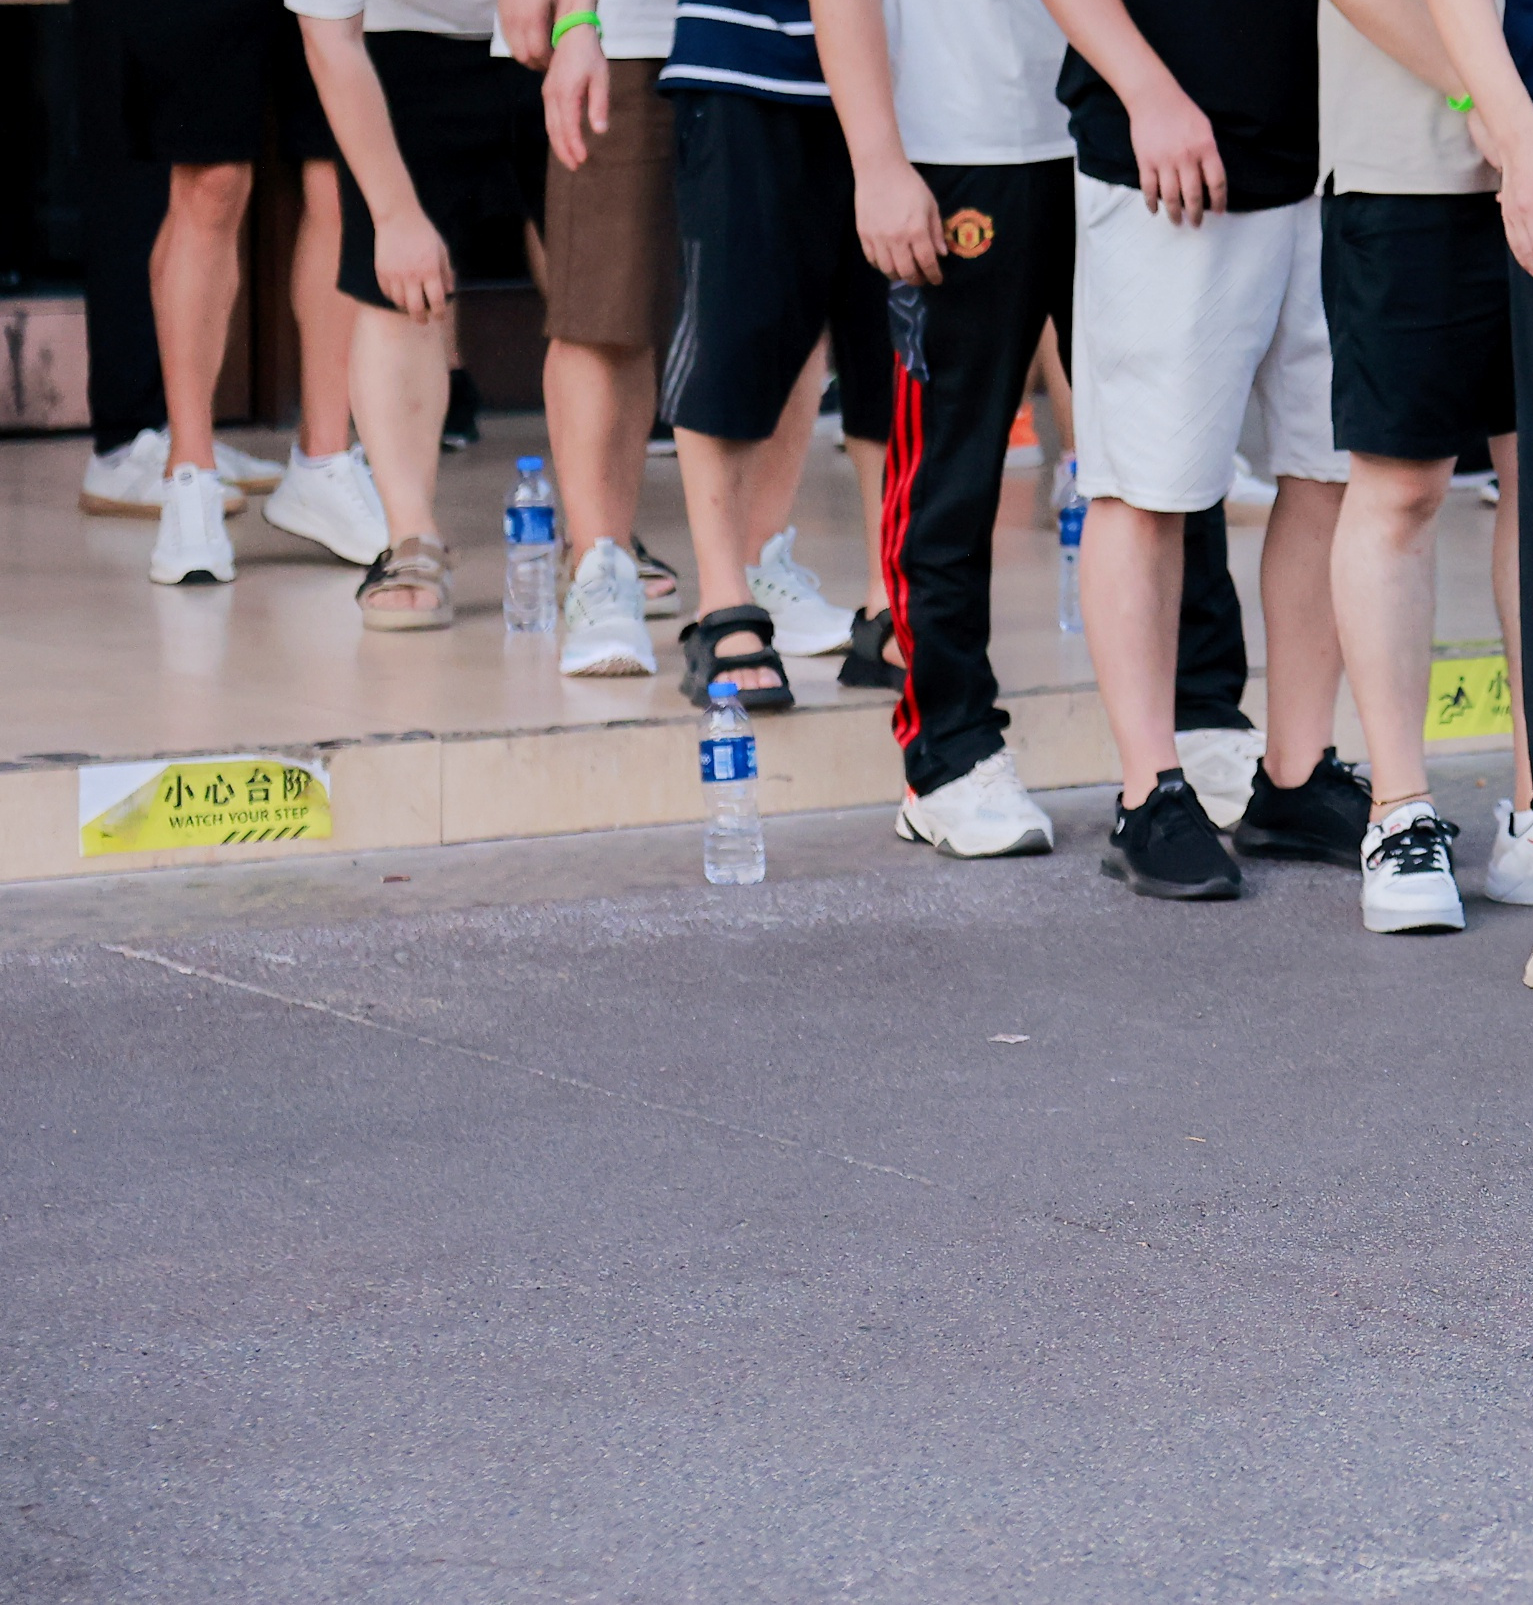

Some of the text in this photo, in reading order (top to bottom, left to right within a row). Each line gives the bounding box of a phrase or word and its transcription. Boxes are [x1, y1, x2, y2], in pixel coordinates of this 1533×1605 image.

[164, 768, 313, 811] 小心台阶
[169, 806, 310, 829] WATCH YOUR STEP
